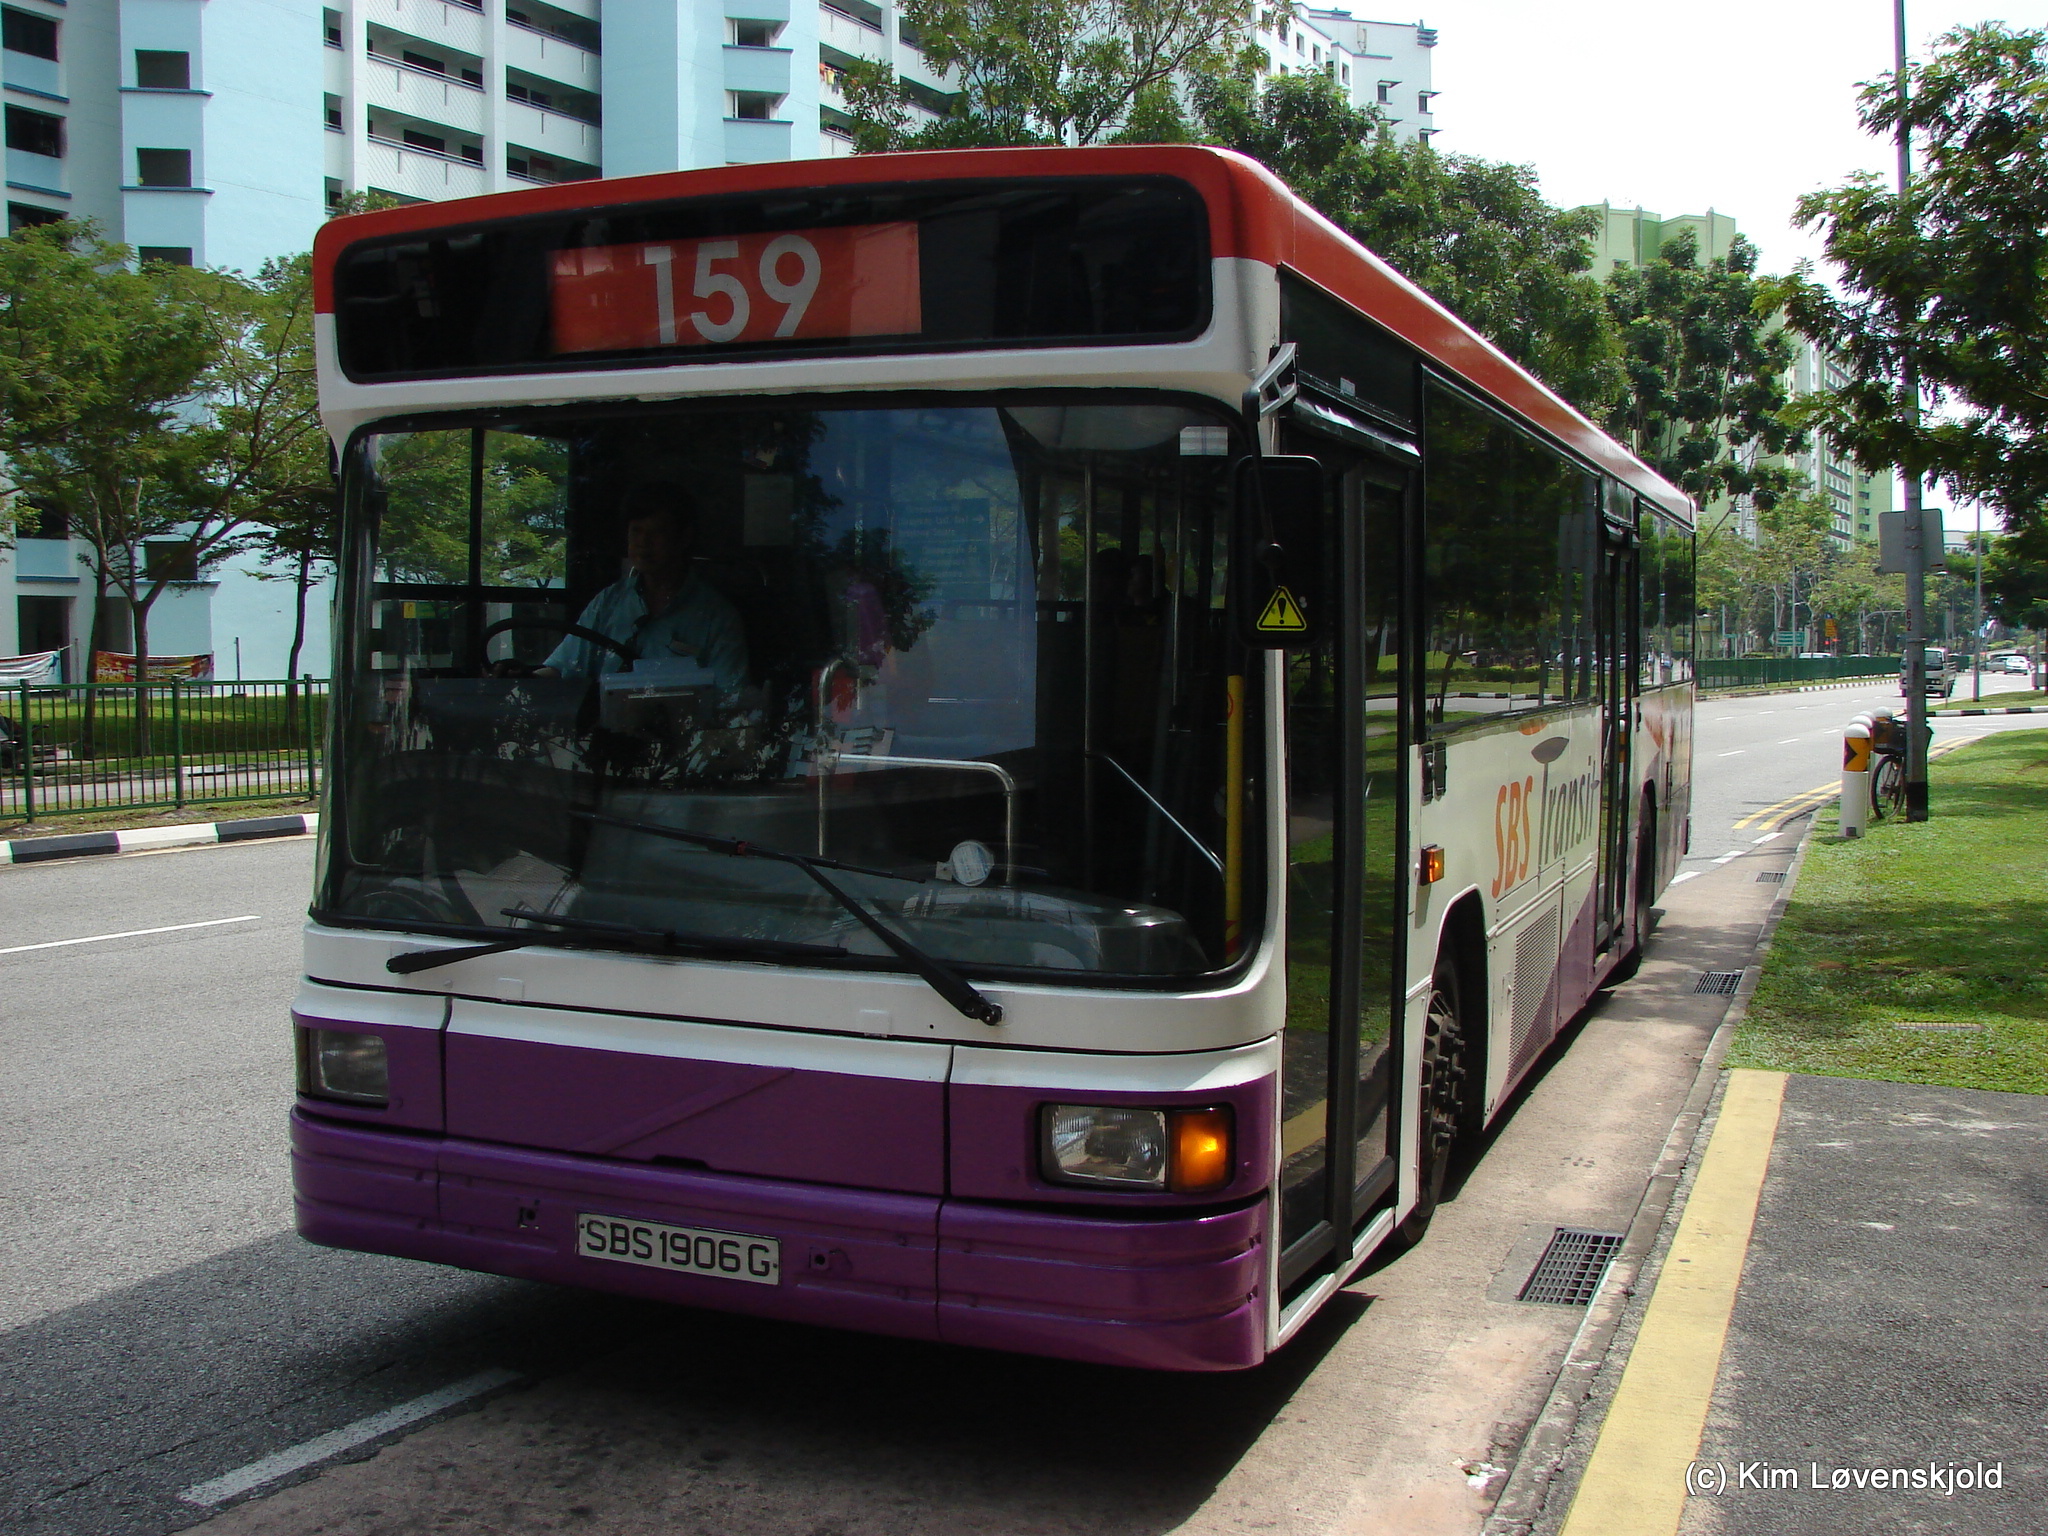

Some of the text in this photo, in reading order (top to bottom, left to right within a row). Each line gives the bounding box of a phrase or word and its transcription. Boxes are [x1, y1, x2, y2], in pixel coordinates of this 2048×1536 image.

[644, 234, 822, 344] 159
[1491, 737, 1600, 898] SBS Transit
